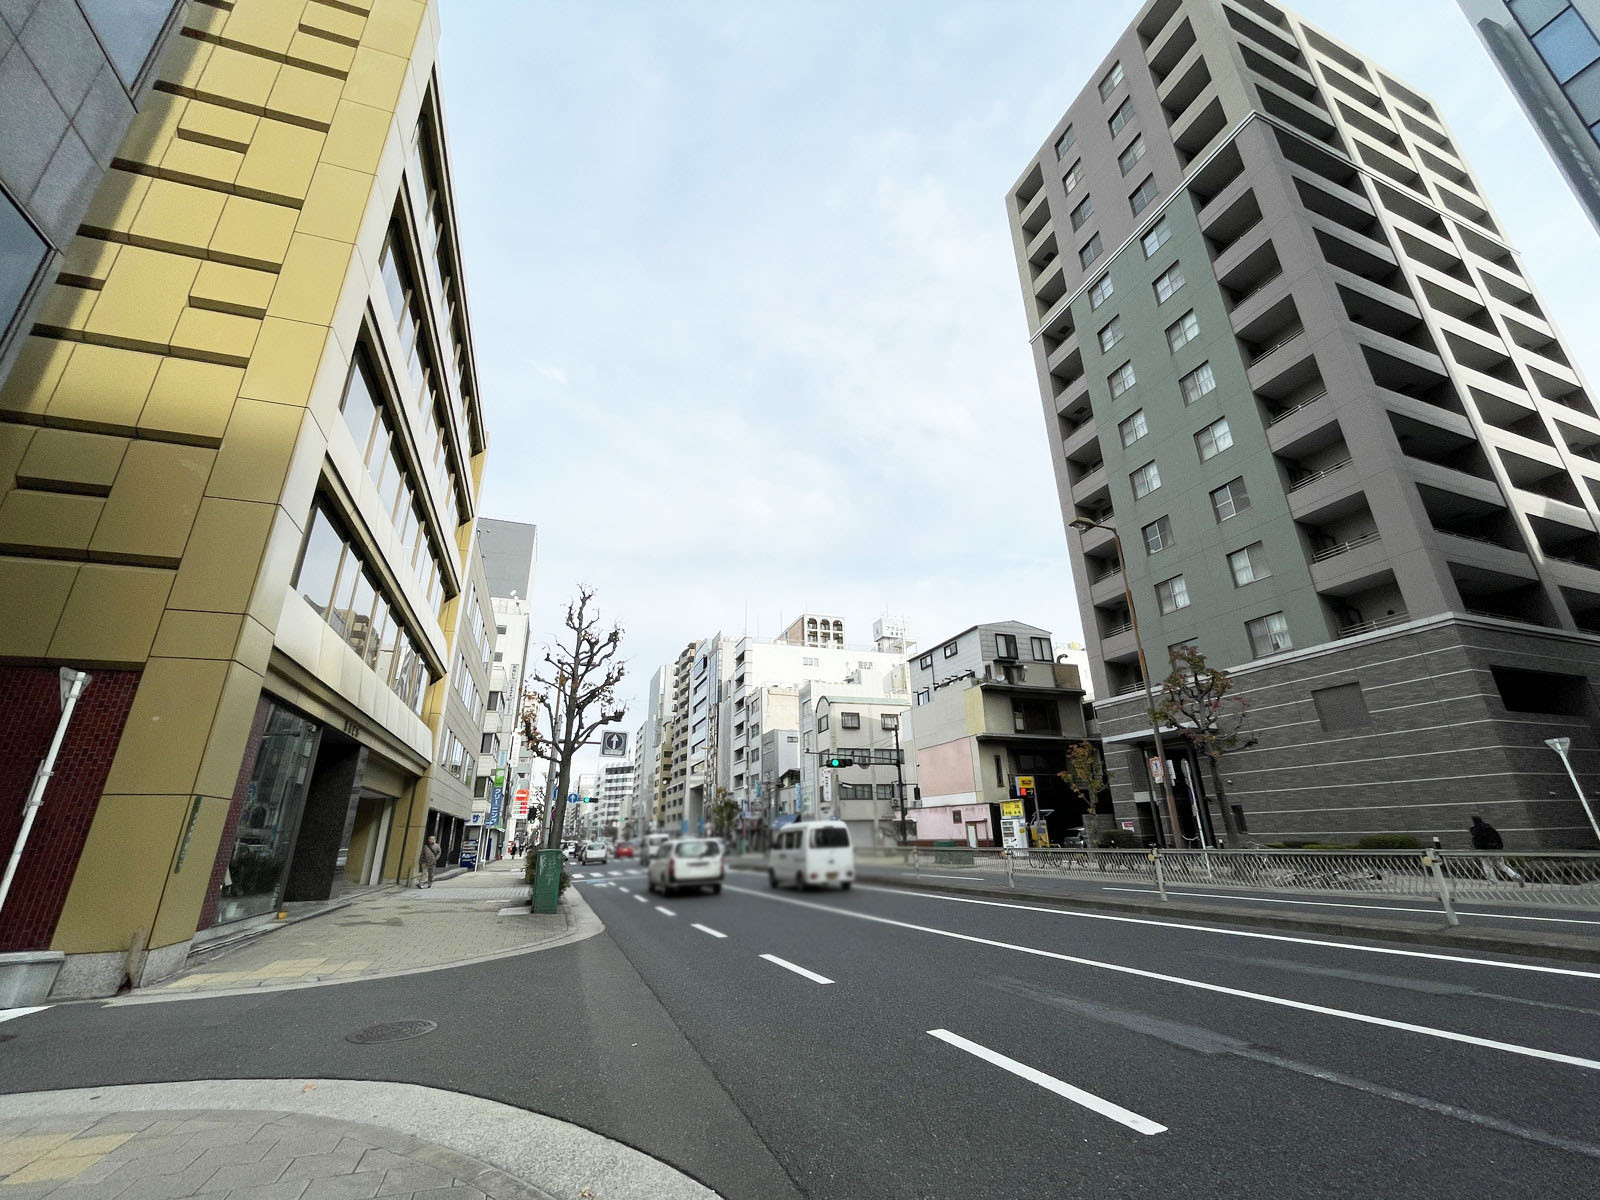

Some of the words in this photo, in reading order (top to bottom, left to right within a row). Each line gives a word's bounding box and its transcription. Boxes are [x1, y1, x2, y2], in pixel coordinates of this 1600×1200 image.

[491, 788, 501, 825] クリーニング
